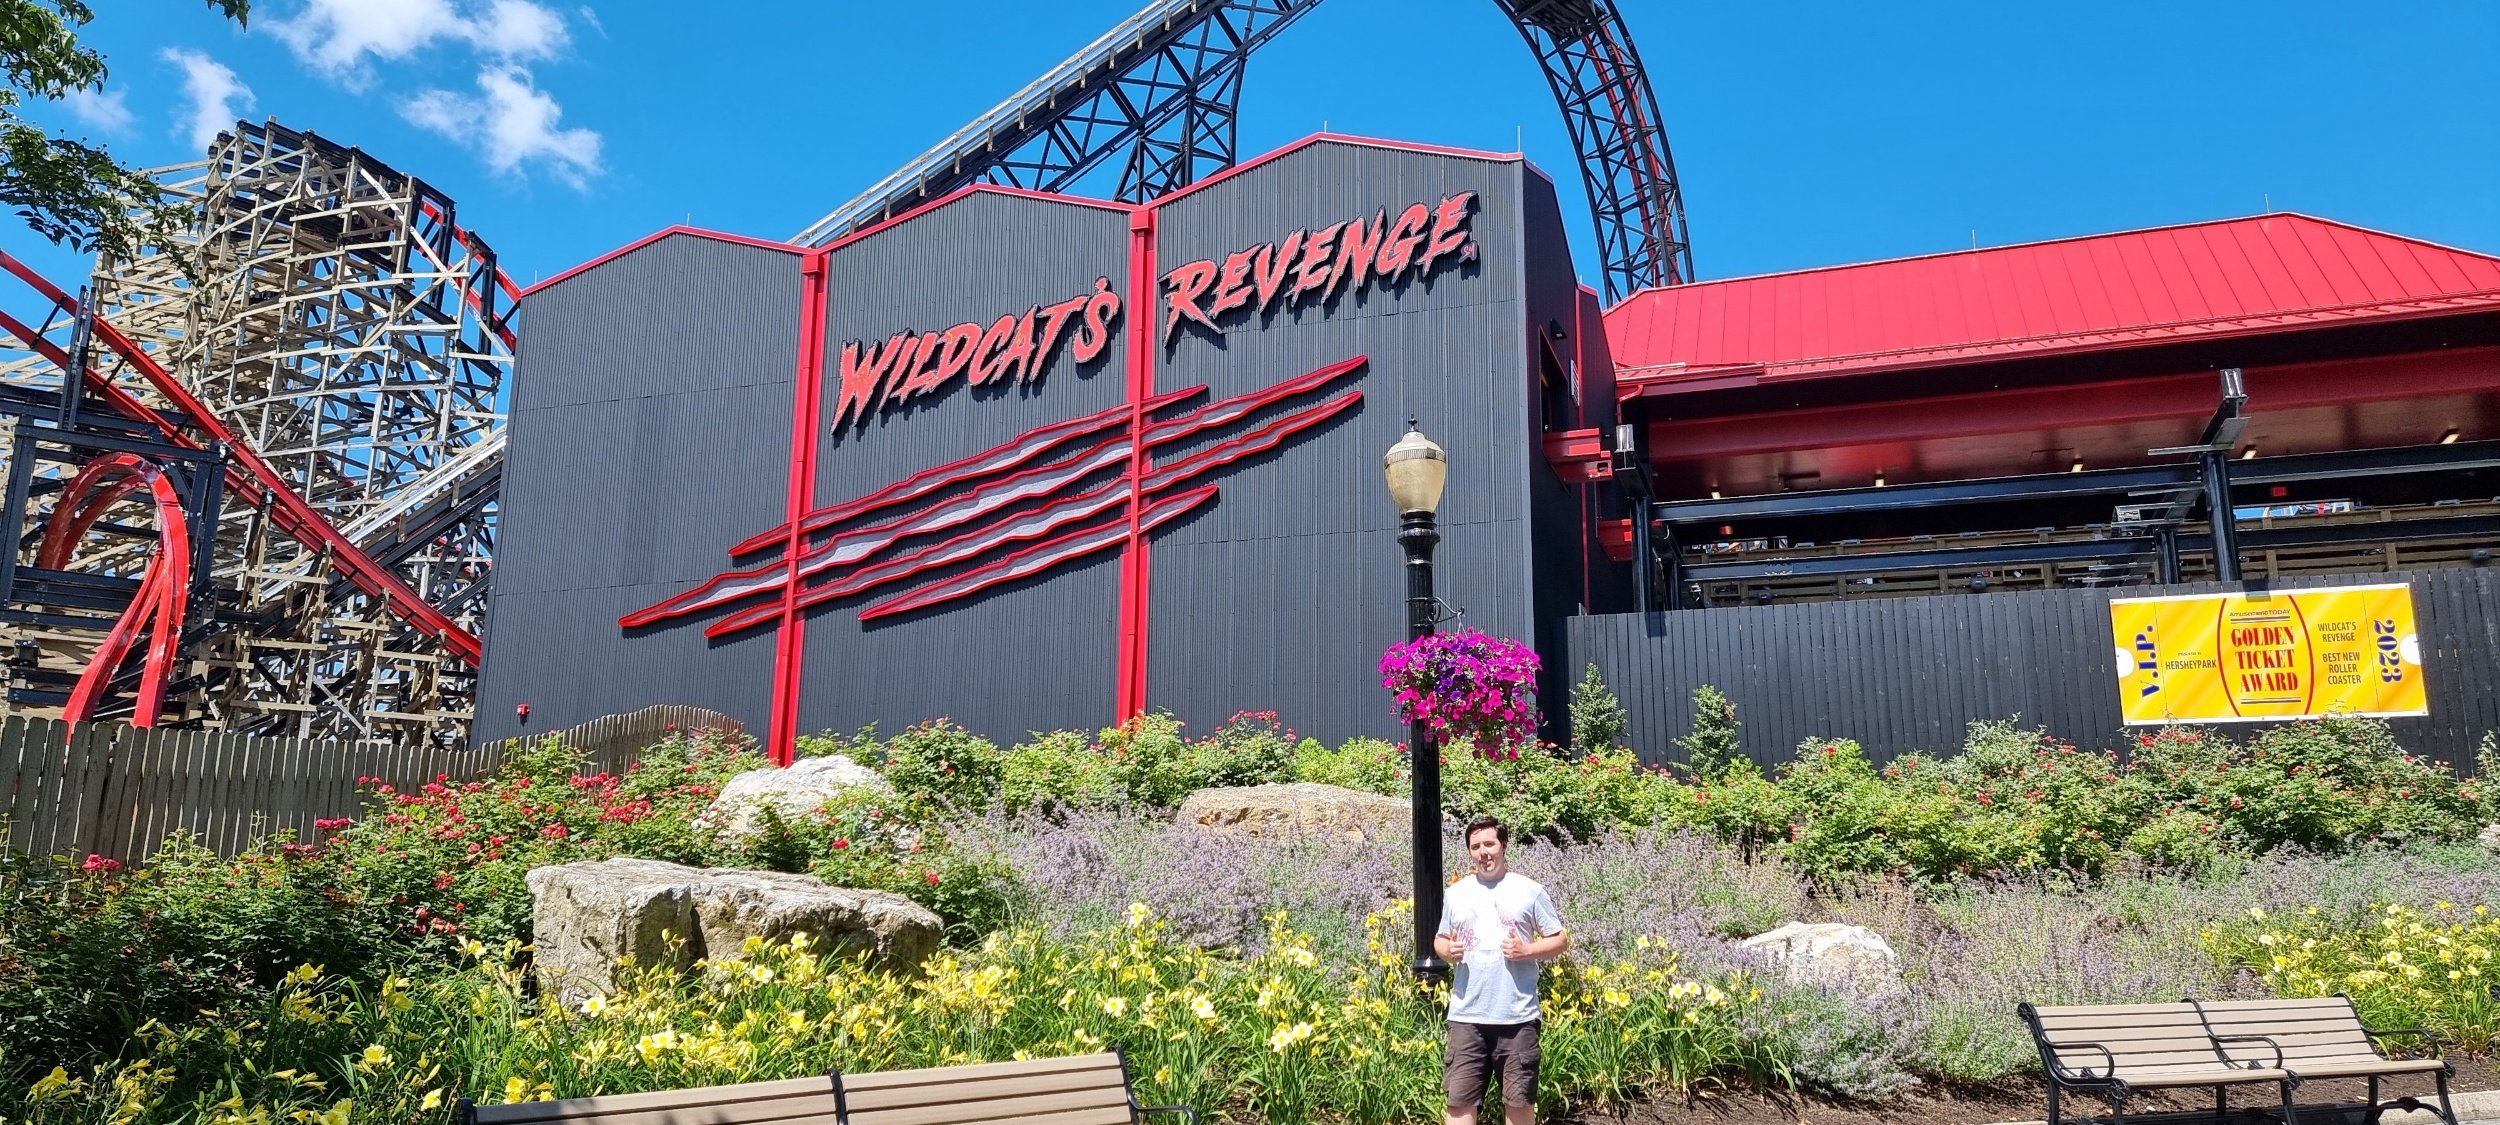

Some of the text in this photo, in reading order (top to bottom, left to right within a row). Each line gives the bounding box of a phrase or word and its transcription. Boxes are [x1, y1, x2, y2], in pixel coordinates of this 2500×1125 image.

[831, 276, 1121, 435] WILDCAT'S
[1160, 190, 1477, 347] REVENGE
[2317, 621, 2357, 632] WILDCAT'S
[2231, 627, 2294, 648] GOLDEN
[2322, 632, 2356, 643] REVENGE
[2322, 651, 2360, 663] BEST NEW
[2373, 619, 2403, 682] 2023
[2136, 625, 2160, 697] V.I.P.
[2165, 659, 2217, 670] HERSHEYPARK
[2235, 649, 2294, 670] TICKET
[2328, 663, 2358, 674] ROLLER
[2241, 672, 2298, 693] AWARD
[2327, 674, 2362, 685] COASTER
